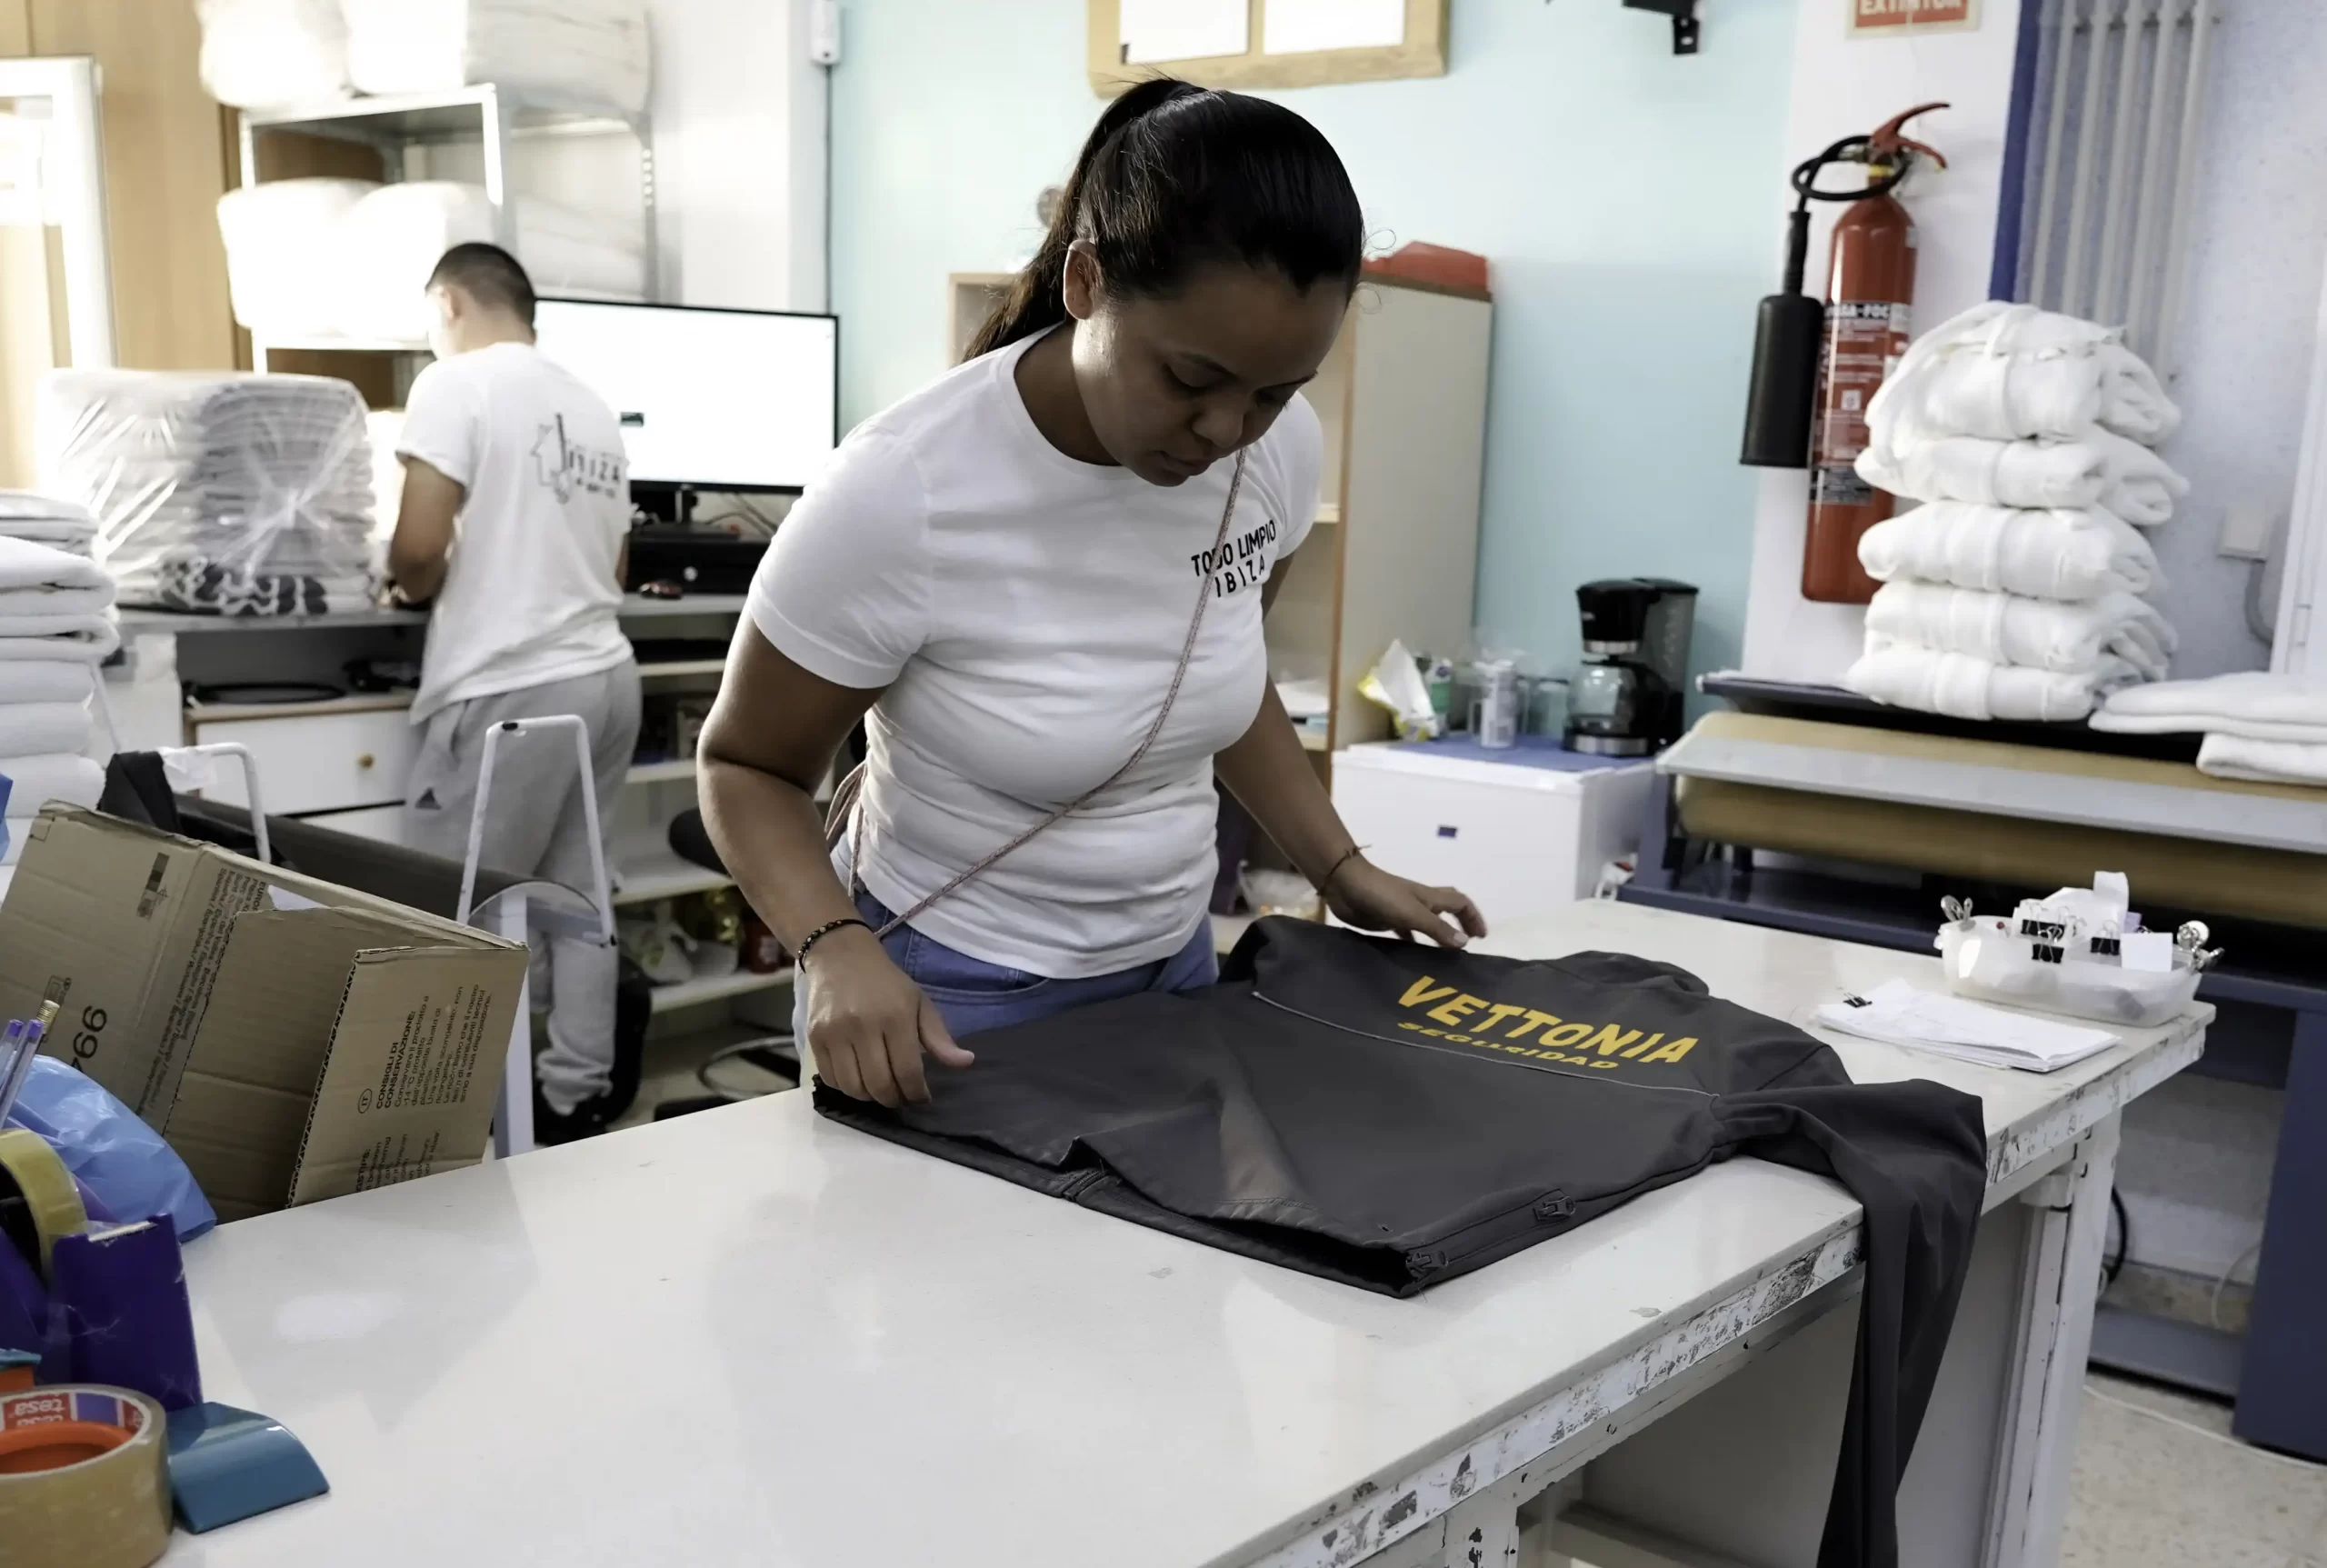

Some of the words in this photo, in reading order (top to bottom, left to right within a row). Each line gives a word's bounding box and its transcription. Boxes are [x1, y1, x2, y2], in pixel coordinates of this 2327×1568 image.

[1238, 520, 1276, 559] LIMPIO
[1214, 554, 1265, 598] IBIZA
[1397, 975, 1699, 1064] VETTONIA
[1397, 1023, 1619, 1069] SEGURIDAD
[376, 1056, 394, 1109] CONSIGLI
[390, 1042, 398, 1054] DI
